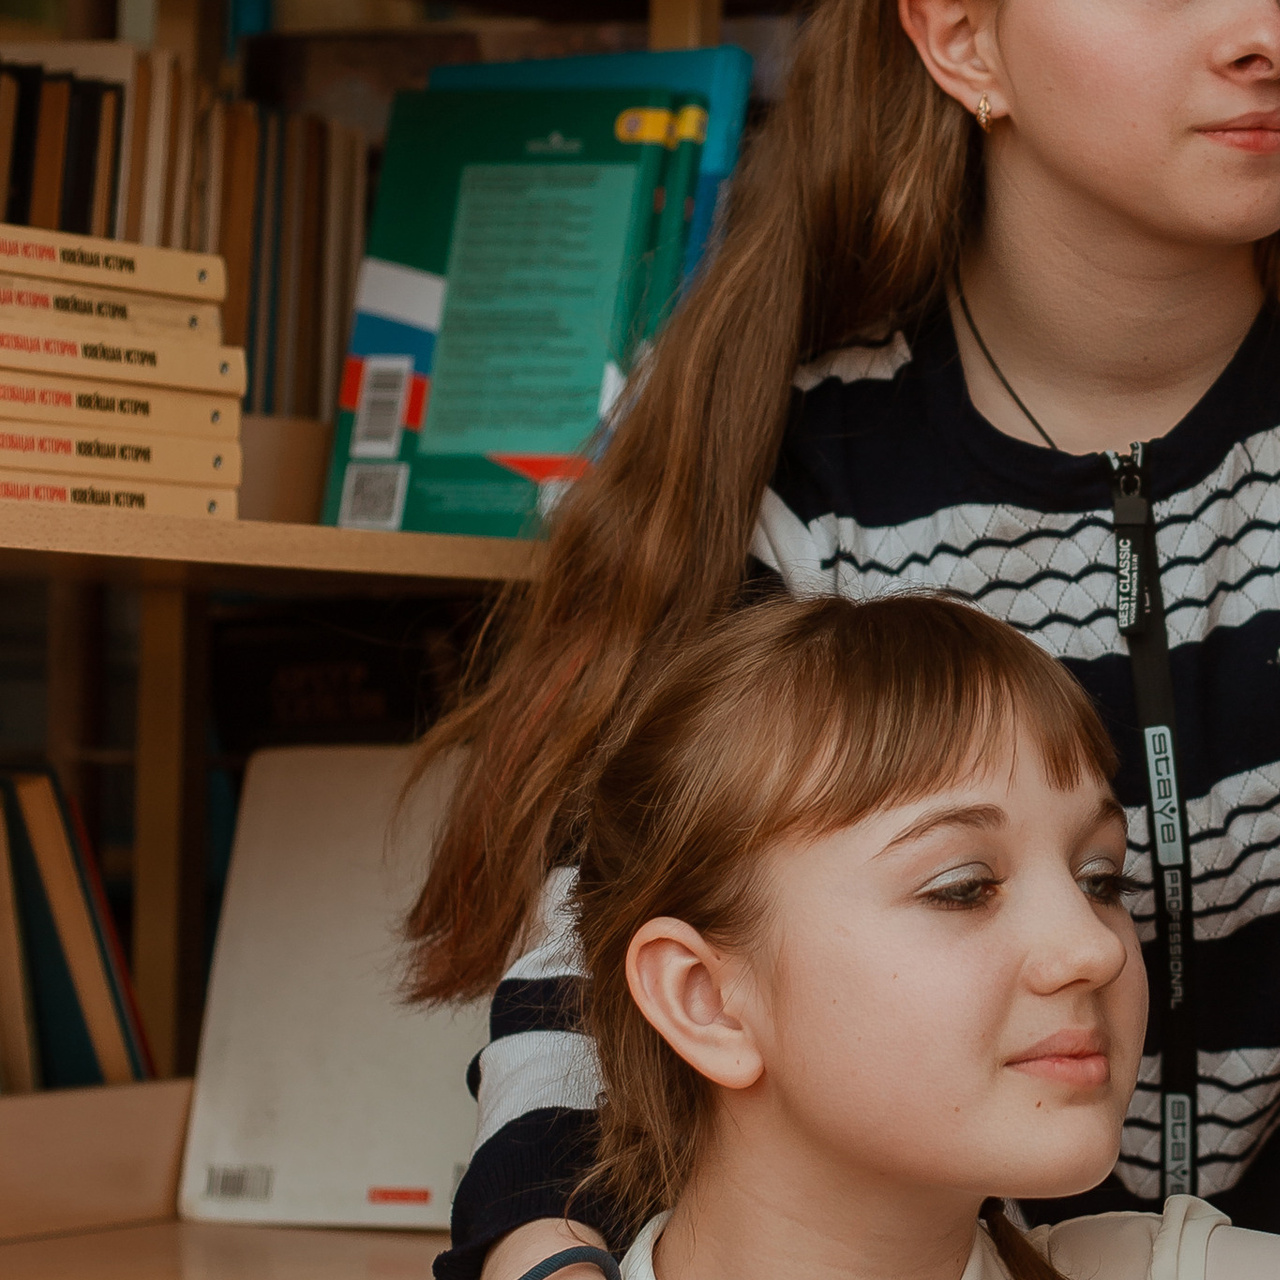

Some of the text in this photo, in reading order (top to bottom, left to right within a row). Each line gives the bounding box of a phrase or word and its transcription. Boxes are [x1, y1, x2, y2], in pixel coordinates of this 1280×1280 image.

[1118, 538, 1131, 628] BEST CLASSIC
[1165, 871, 1182, 1010] PROFESSIONAL
